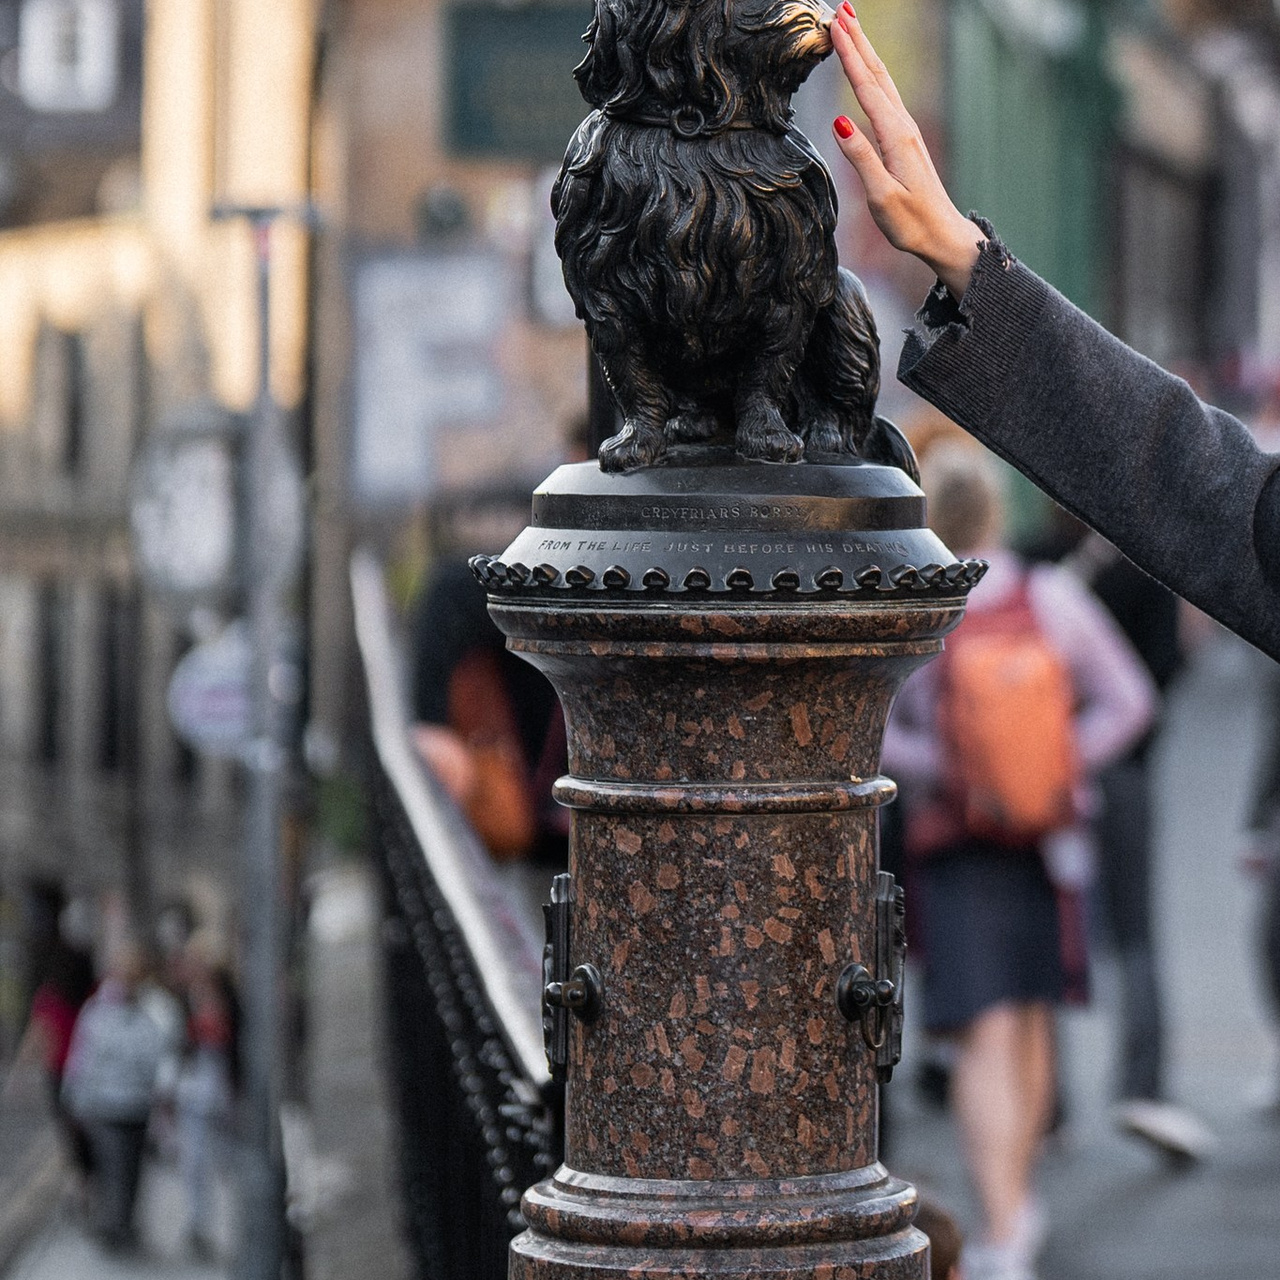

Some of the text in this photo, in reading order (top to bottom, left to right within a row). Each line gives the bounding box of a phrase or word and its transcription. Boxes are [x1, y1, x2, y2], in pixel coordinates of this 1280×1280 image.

[641, 506, 741, 519] GREYFRIARS
[538, 540, 572, 551] FROM
[577, 540, 607, 551] THE
[612, 541, 651, 553] LIFE
[664, 542, 714, 553] JUST
[724, 543, 796, 554] BEFORE
[806, 543, 833, 554] HIS
